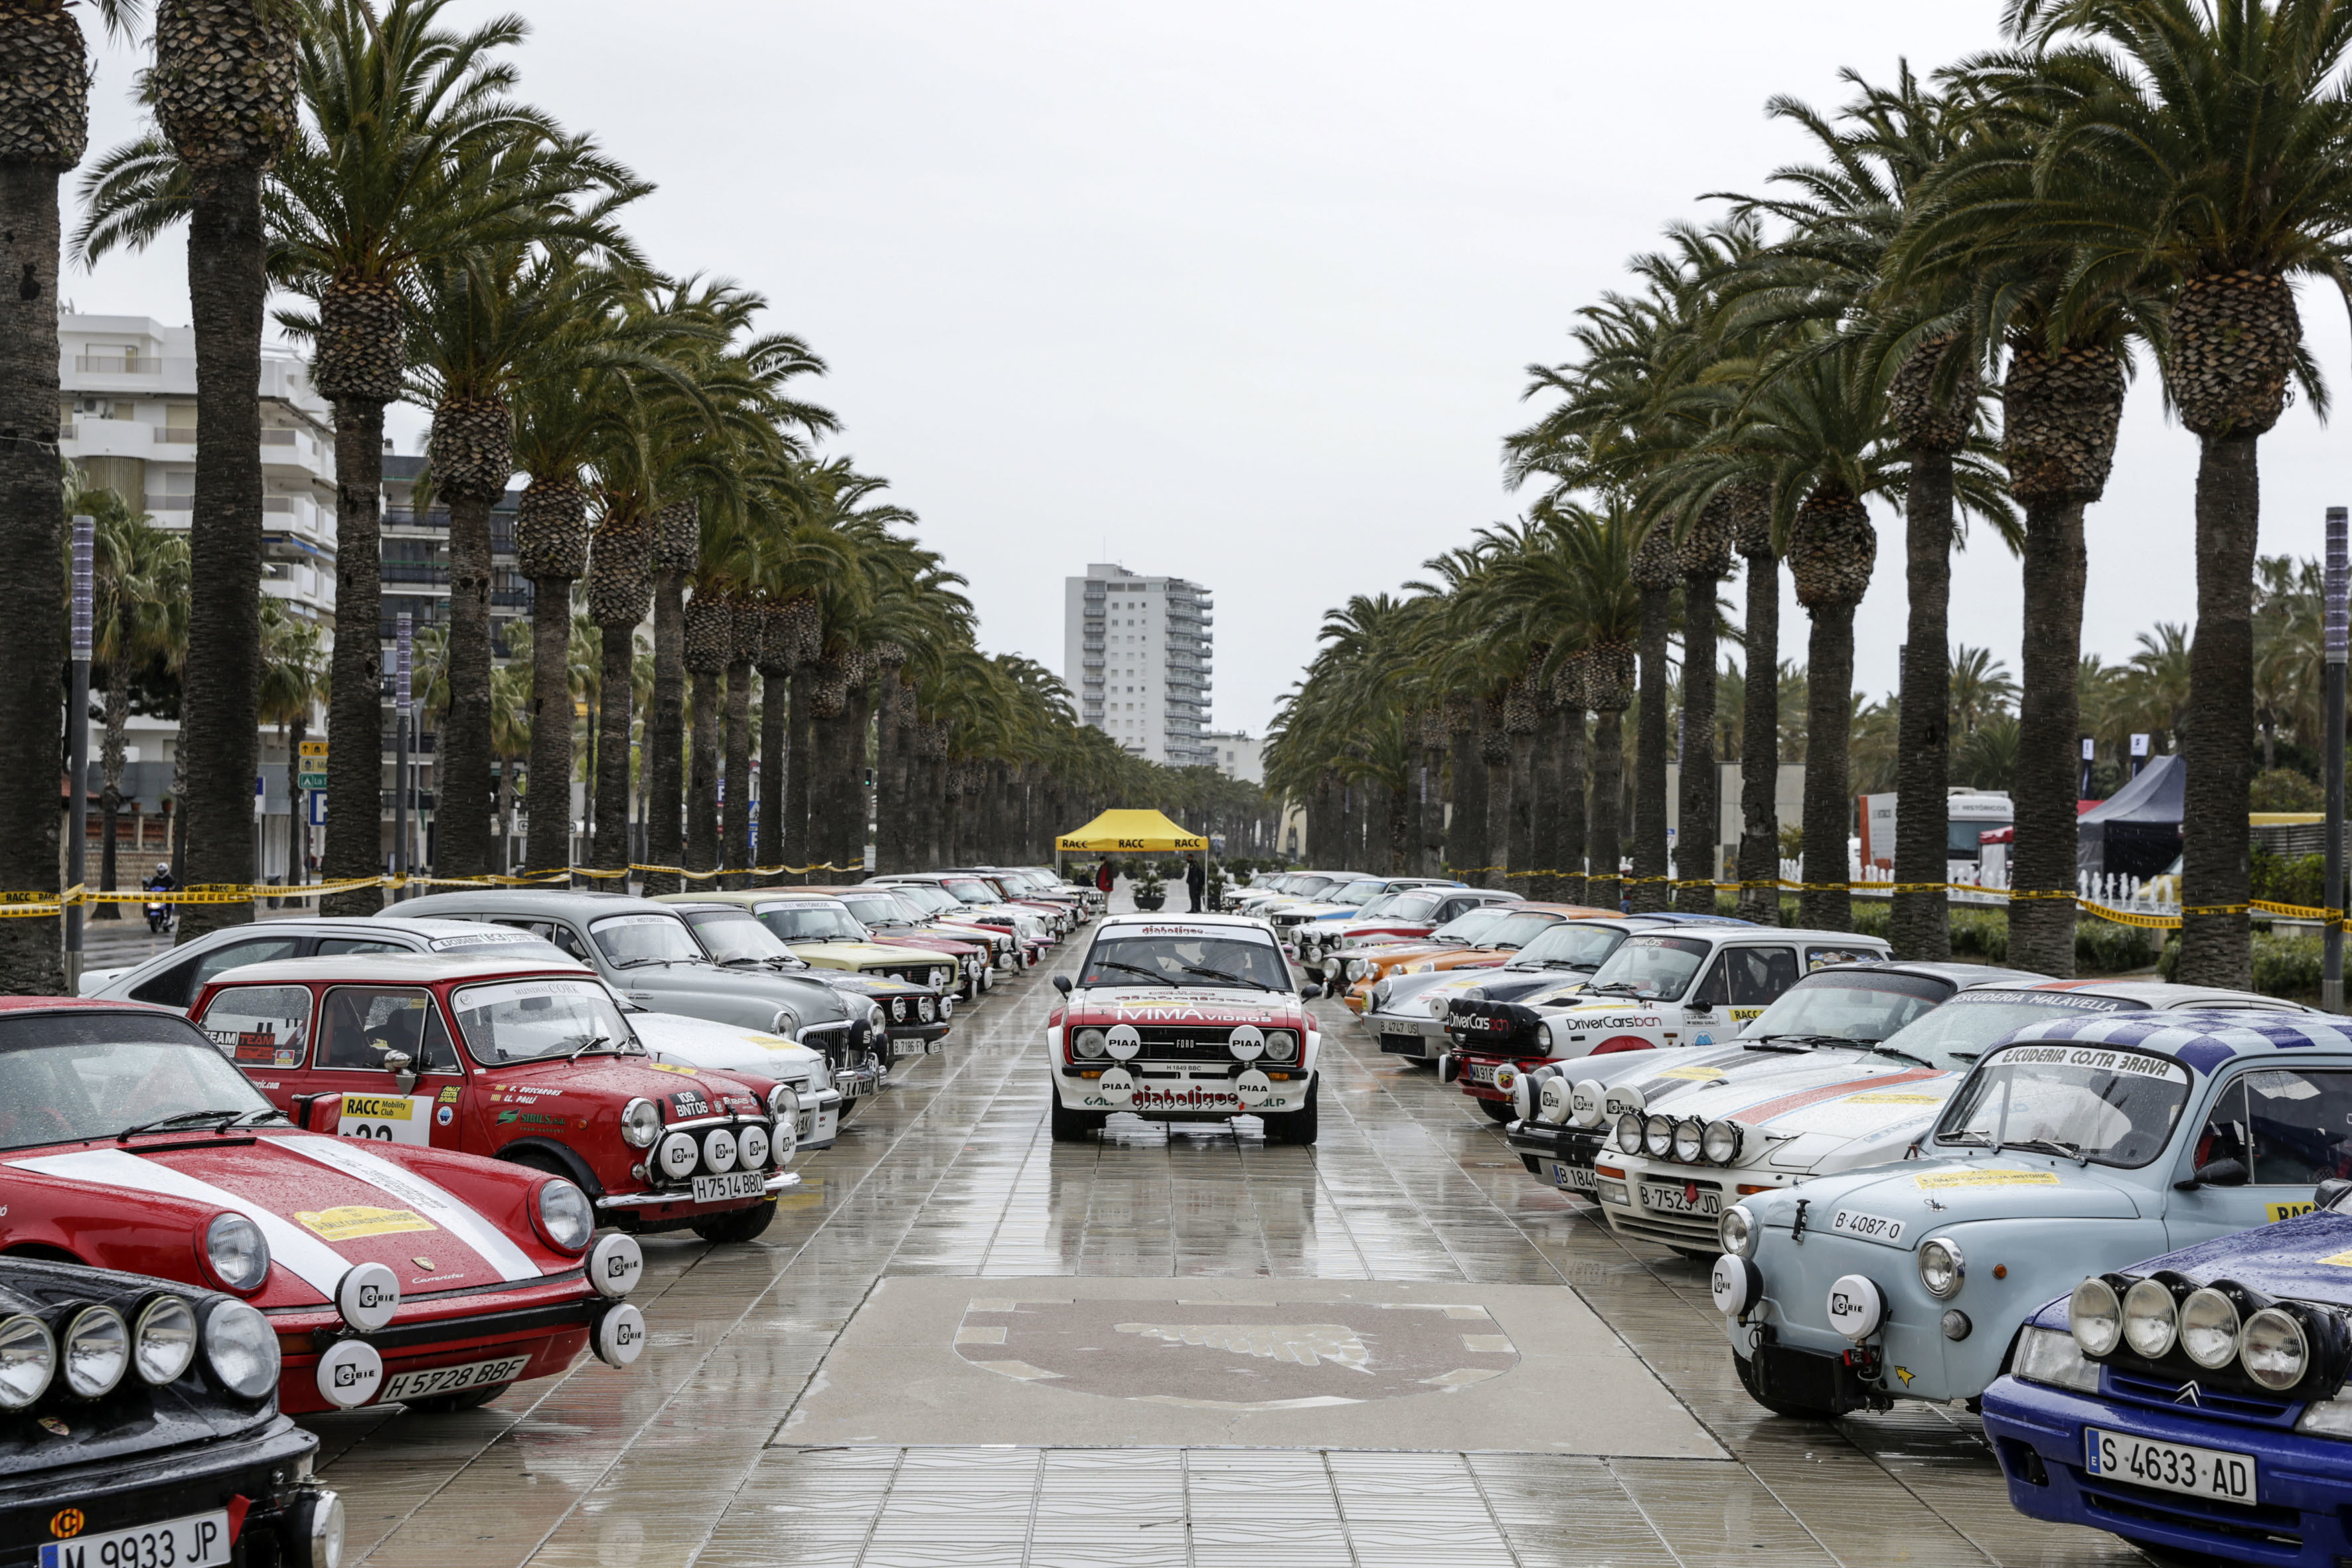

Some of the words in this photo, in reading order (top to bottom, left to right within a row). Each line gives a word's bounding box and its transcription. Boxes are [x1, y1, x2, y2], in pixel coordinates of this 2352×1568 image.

[1062, 838, 1088, 848] RACC
[1119, 838, 1144, 848] RACC
[1174, 838, 1200, 848] RACC
[209, 884, 229, 893] RACC
[6, 892, 31, 902] RACC
[2028, 994, 2119, 1012] MALAVELLA
[1205, 1014, 1272, 1023] VIDROS
[240, 1034, 274, 1045] TEAM
[1176, 1039, 1194, 1048] FORD
[2002, 1048, 2067, 1063] ESCUDERIA
[2070, 1050, 2117, 1067] COSTA
[519, 1086, 563, 1096] BUSCARONS
[677, 1092, 696, 1103] 109
[347, 1099, 380, 1115] RACC
[382, 1101, 406, 1111] Mobility
[1559, 1168, 1568, 1184] B
[696, 1179, 706, 1200] H
[709, 1176, 741, 1198] 7514
[744, 1173, 763, 1194] BBD
[386, 1375, 410, 1399] H
[410, 1367, 472, 1394] 5728
[474, 1358, 526, 1385] BBF
[2092, 1456, 2097, 1466] E
[2102, 1438, 2117, 1472] S
[2130, 1443, 2197, 1488] 4633
[2213, 1458, 2247, 1497] AD
[101, 1529, 175, 1568] 9933
[187, 1521, 218, 1563] JP
